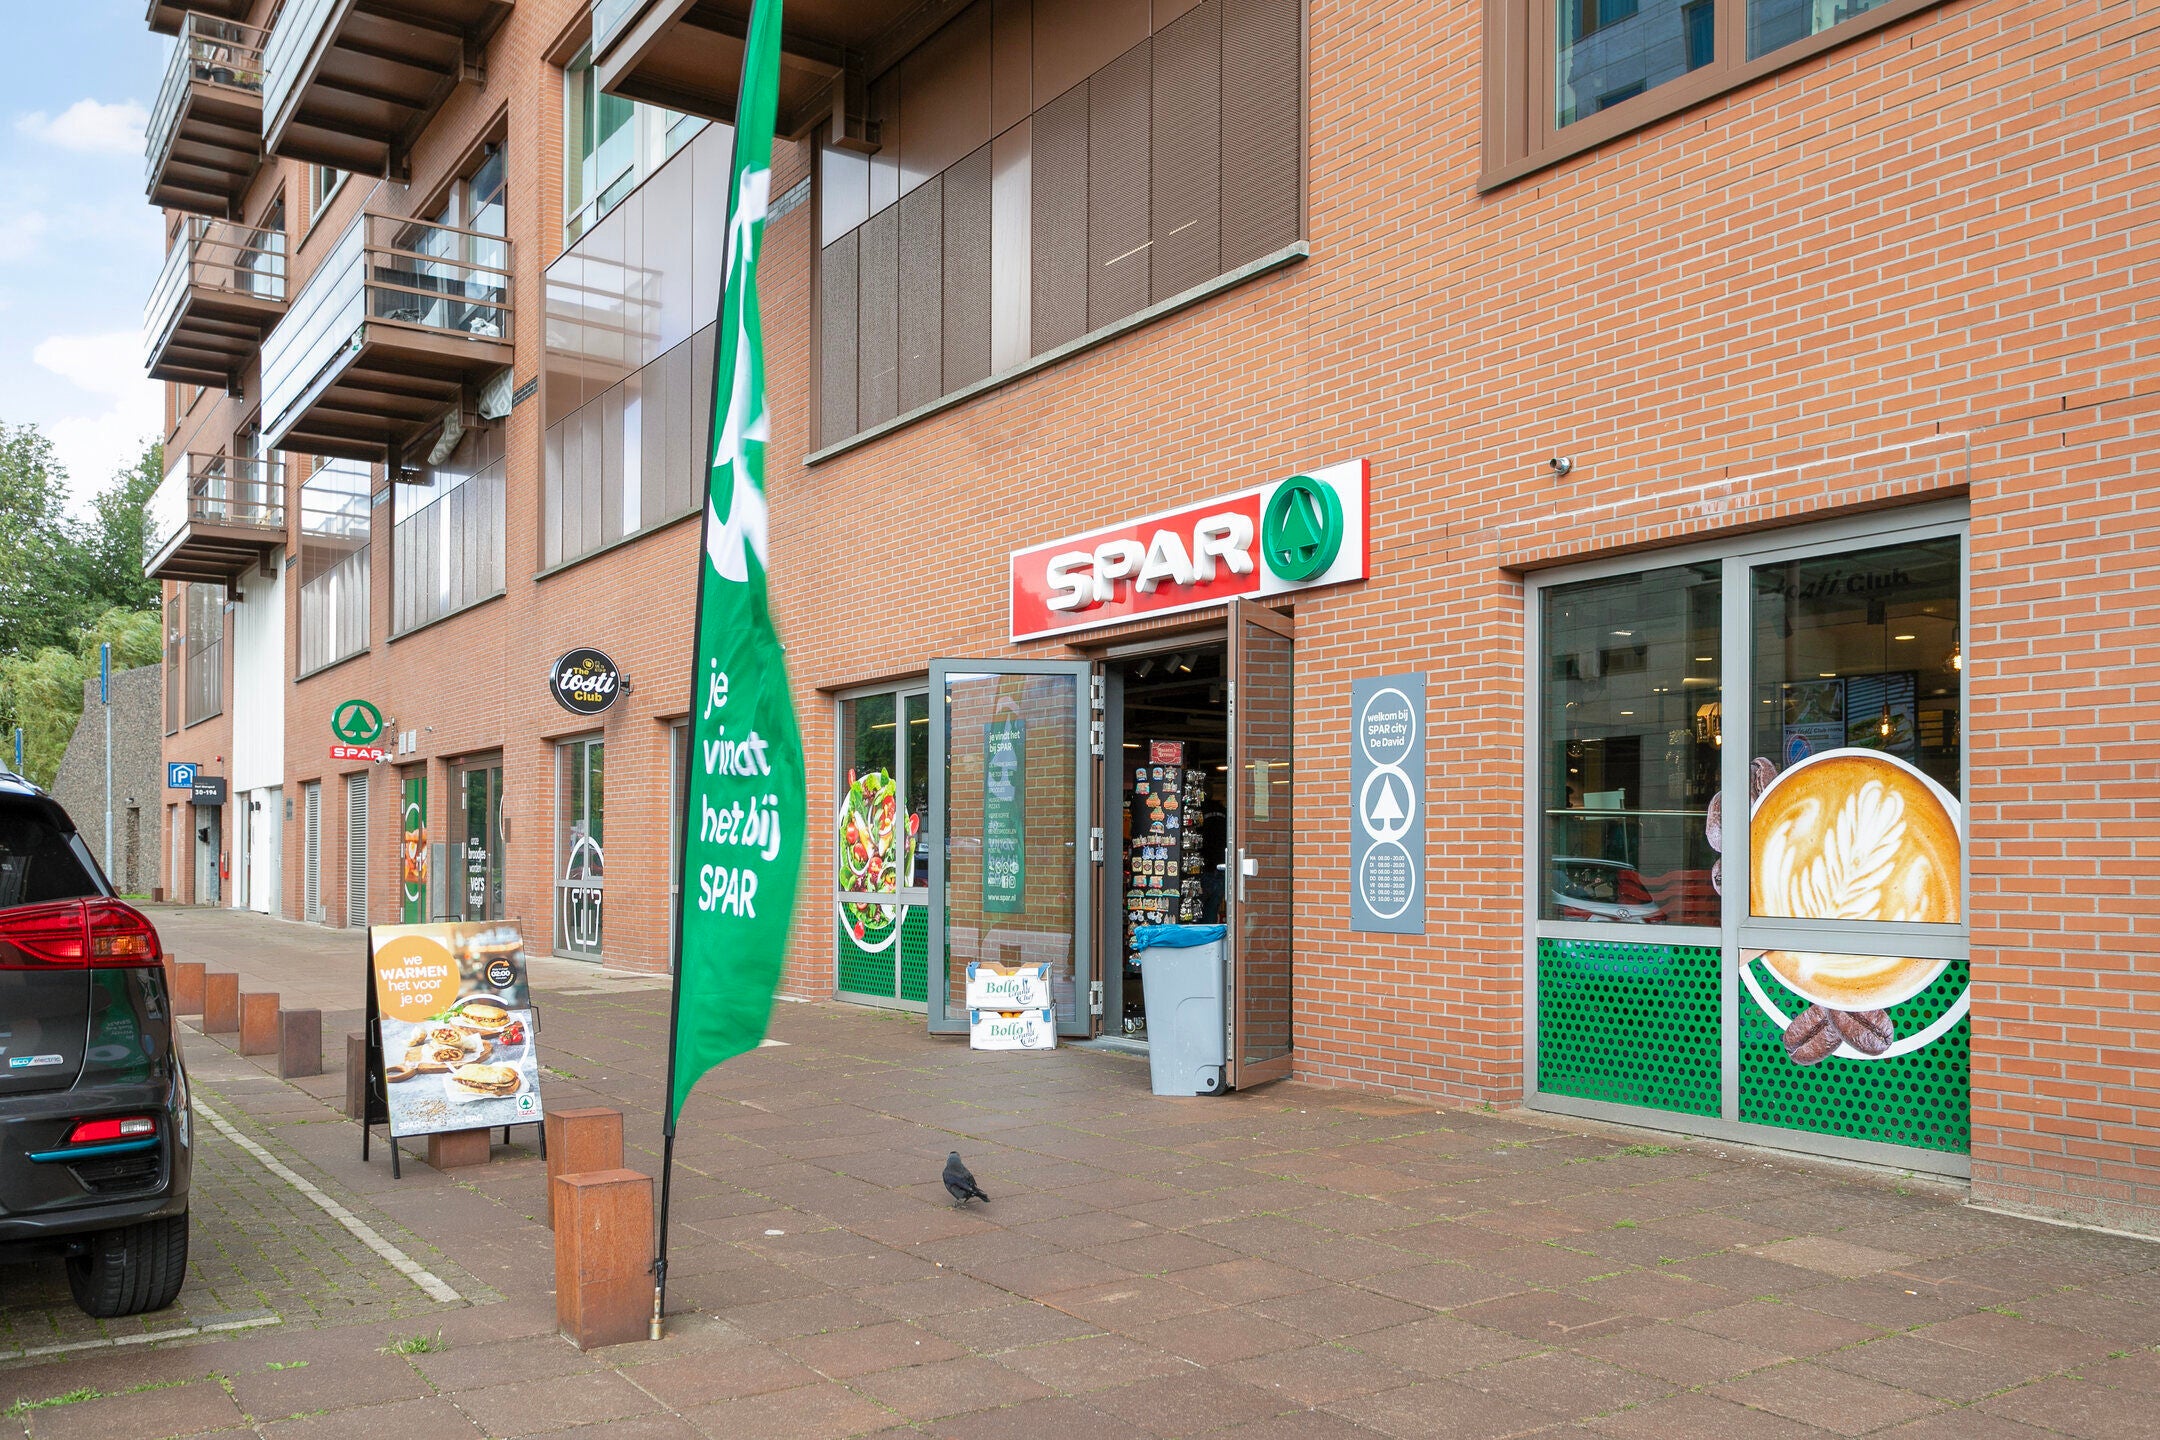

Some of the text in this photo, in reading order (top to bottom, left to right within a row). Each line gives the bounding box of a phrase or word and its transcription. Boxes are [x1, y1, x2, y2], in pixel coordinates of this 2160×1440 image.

[1046, 511, 1254, 612] SPAR
[573, 667, 589, 675] The
[560, 668, 616, 693] tosti
[703, 657, 729, 720] je
[574, 690, 603, 702] Club
[1367, 709, 1409, 722] welkom bij
[1368, 722, 1407, 735] SPAR city
[989, 730, 1020, 744] je vindt het
[1370, 736, 1405, 748] De David
[334, 747, 382, 759] SPAR
[703, 725, 771, 776] vindt
[989, 742, 1012, 755] bij SPAR
[700, 793, 780, 861] het bij
[470, 837, 480, 845] onze
[468, 847, 487, 862] broodjes
[470, 877, 485, 891] vers
[698, 864, 758, 918] SPAR
[403, 955, 422, 965] we
[380, 965, 448, 980] WARMEN
[388, 979, 443, 992] het voor
[986, 979, 1020, 993] Bollo
[400, 993, 433, 1007] je op
[991, 1022, 1023, 1036] Bollo
[398, 1120, 420, 1130] SPAR
